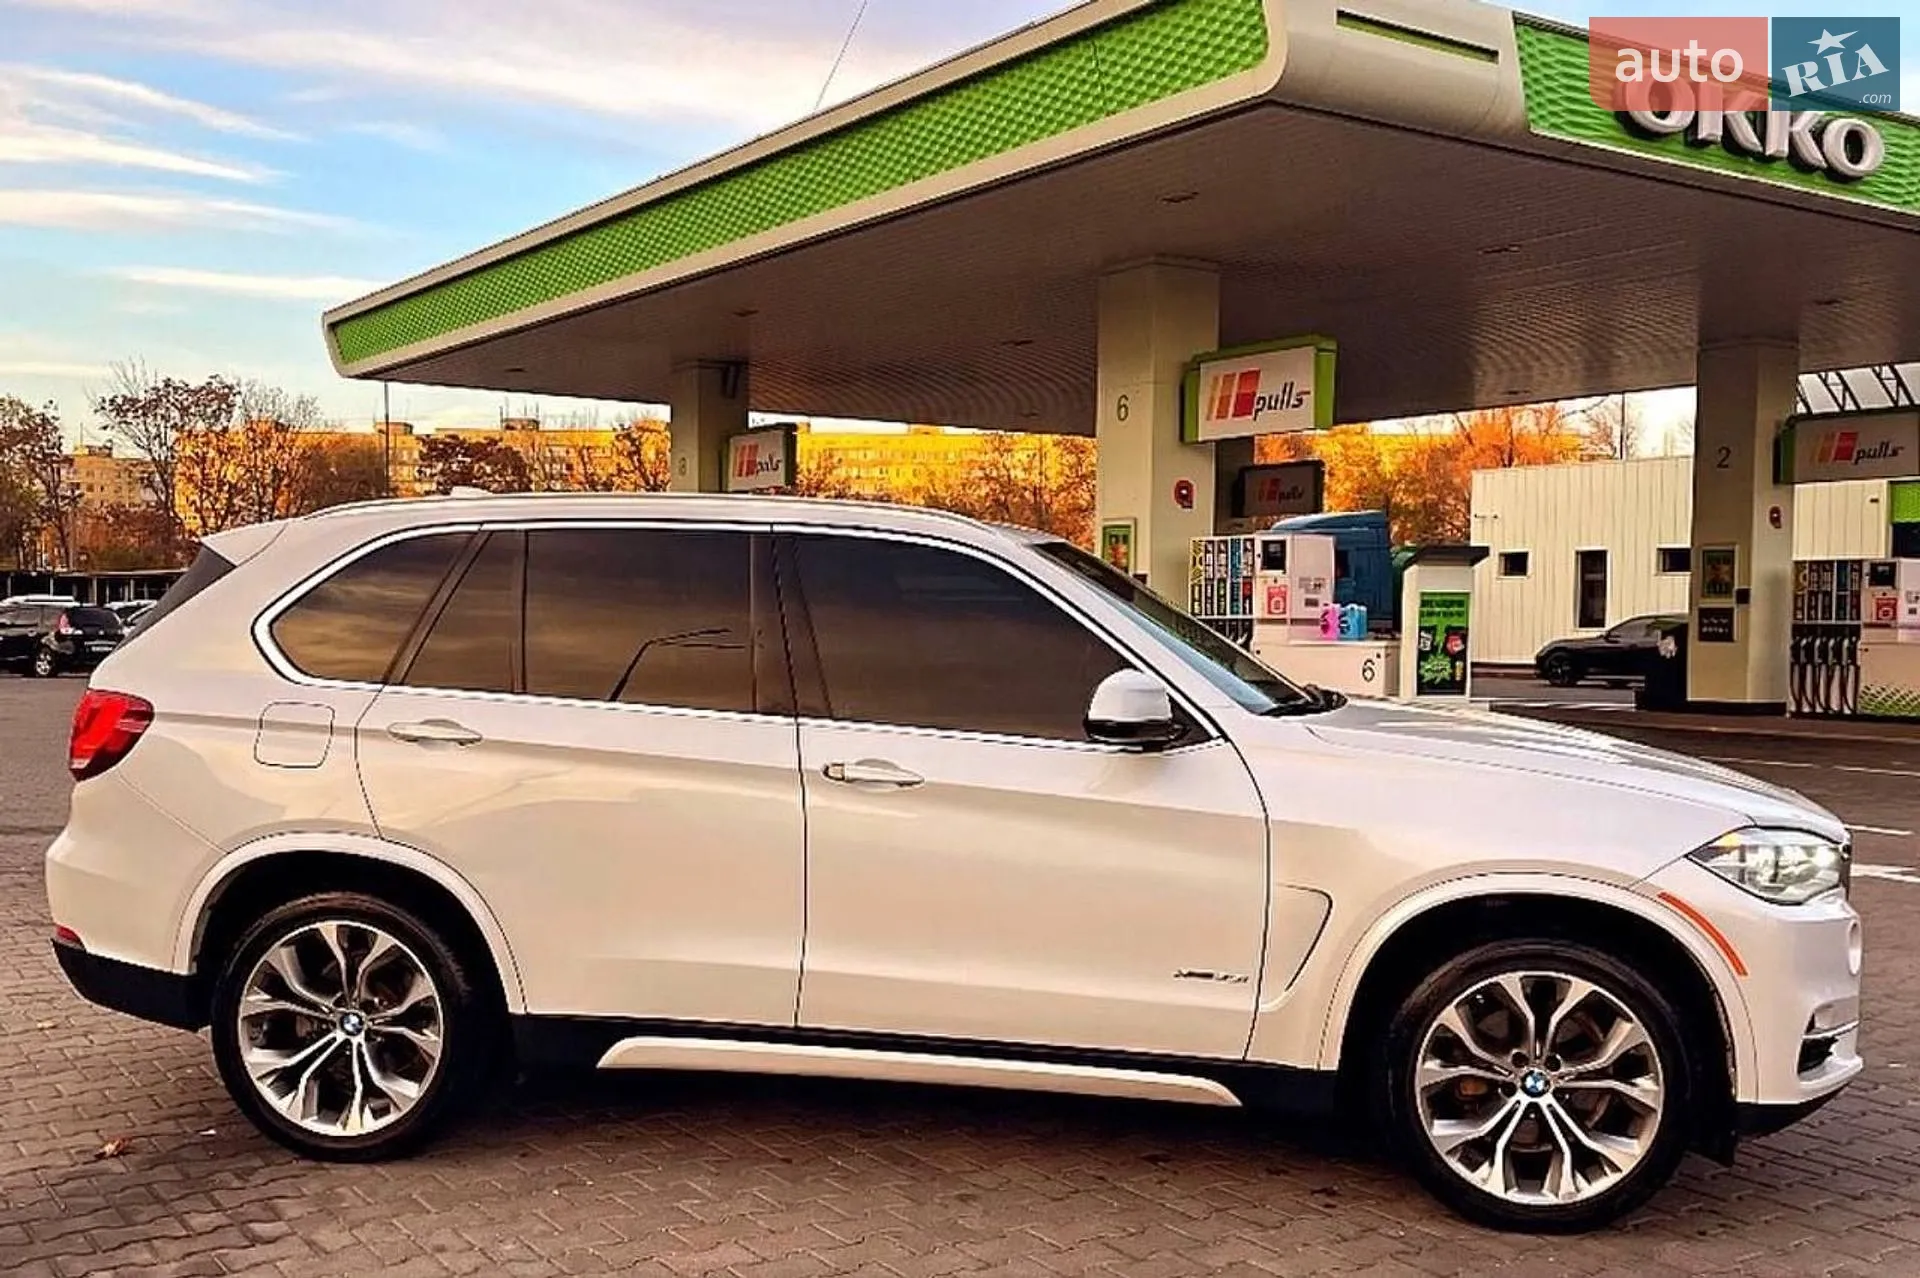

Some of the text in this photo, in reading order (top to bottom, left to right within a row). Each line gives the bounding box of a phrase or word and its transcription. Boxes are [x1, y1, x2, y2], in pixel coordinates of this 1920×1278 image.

[1117, 394, 1129, 422] 6
[1253, 381, 1311, 421] pulls
[1716, 446, 1731, 469] 2
[1362, 658, 1375, 682] 6
